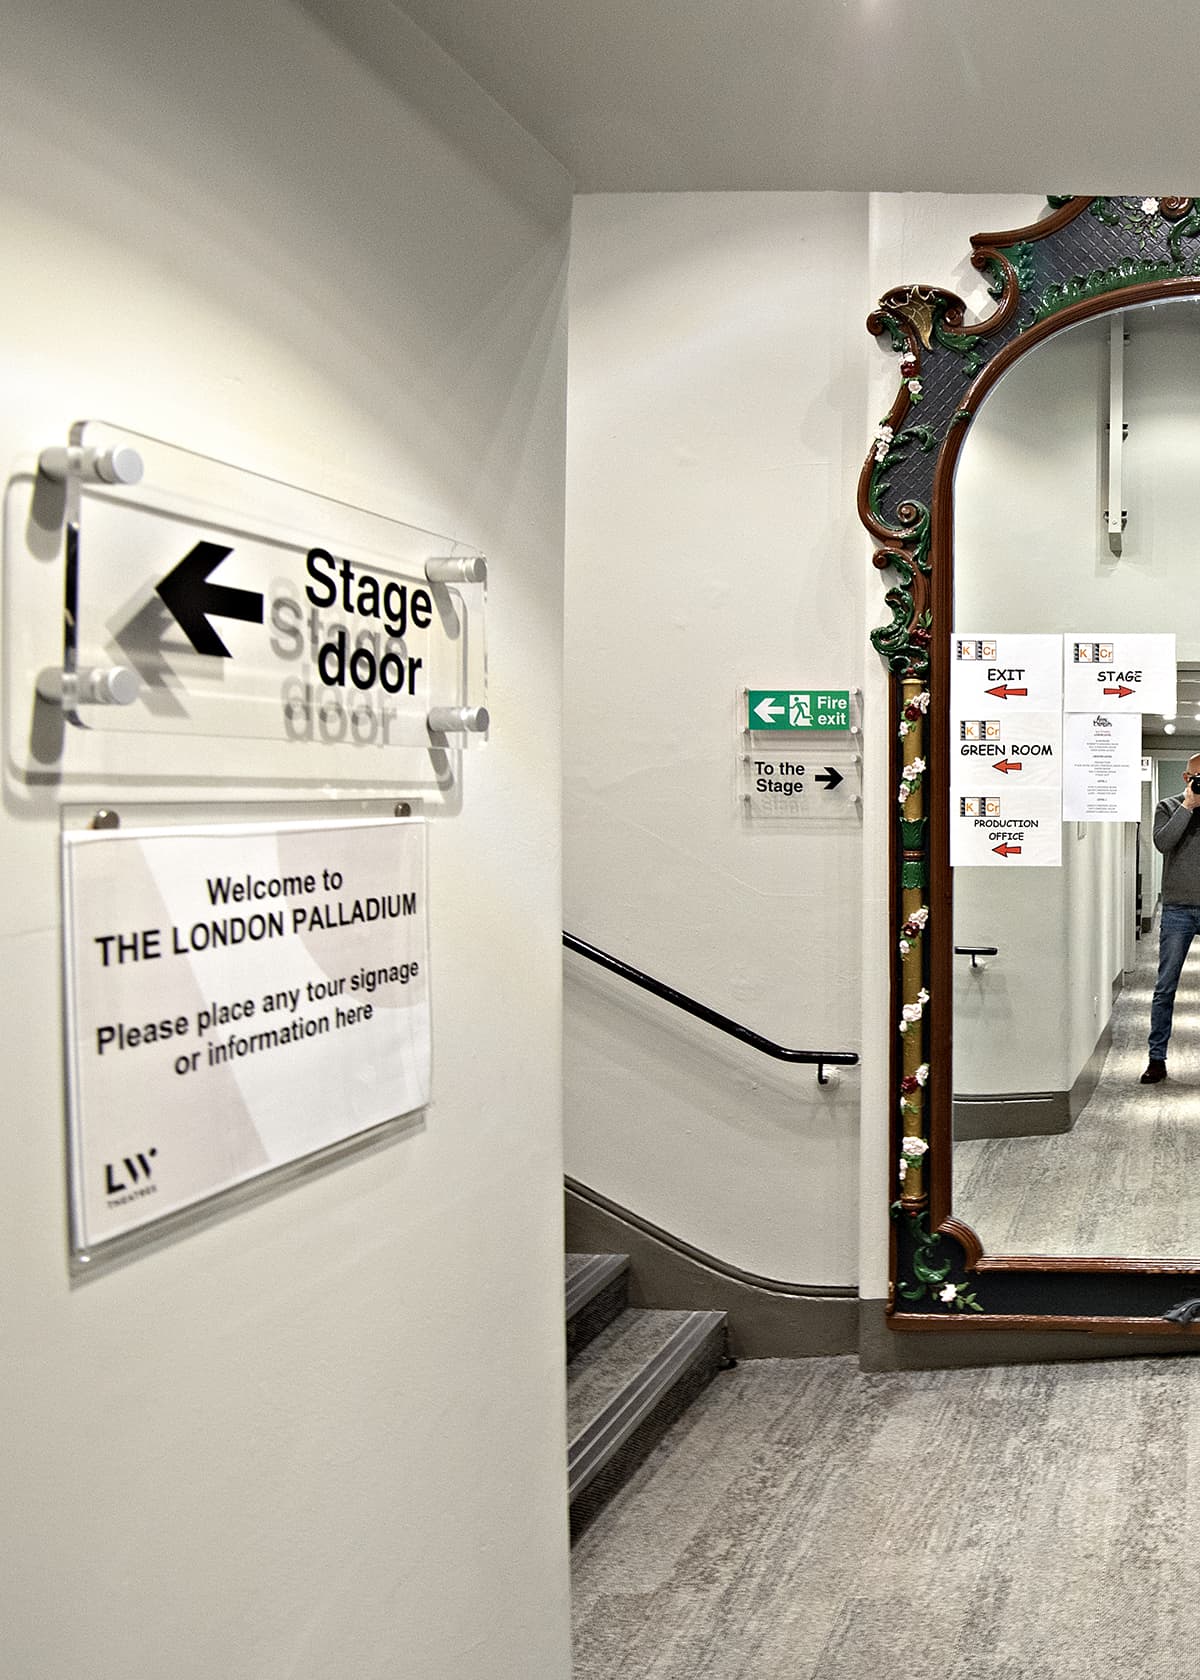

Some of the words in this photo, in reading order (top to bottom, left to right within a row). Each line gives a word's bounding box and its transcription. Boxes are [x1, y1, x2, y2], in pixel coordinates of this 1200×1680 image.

[305, 548, 432, 637] Stage
[963, 646, 970, 655] K
[983, 646, 995, 656] Cr
[1080, 649, 1087, 658] K
[1100, 649, 1112, 658] Cr
[317, 631, 422, 695] door
[987, 669, 1025, 681] EXIT
[1097, 671, 1142, 682] STAGE
[818, 696, 847, 709] Fire
[818, 712, 846, 725] exit
[966, 727, 974, 736] K
[986, 726, 999, 736] Cr
[960, 744, 1006, 756] GREEN
[1011, 745, 1053, 756] ROOM
[754, 762, 774, 775] To
[779, 762, 805, 775] the
[756, 778, 803, 796] Stage
[966, 803, 974, 812] K
[986, 803, 999, 812] Cr
[974, 819, 1039, 828] PRODUCTION
[988, 831, 1024, 841] OFFICE
[207, 873, 316, 905] Welcome
[322, 868, 343, 890] to
[94, 930, 161, 966] THE
[173, 911, 284, 955] LONDON
[293, 892, 417, 934] PALLADIUM
[97, 1015, 189, 1055] Please
[197, 998, 255, 1037] place
[262, 989, 299, 1013] any
[307, 977, 346, 1002] tour
[350, 960, 419, 992] signage
[175, 1050, 201, 1075] or
[208, 1015, 331, 1067] information
[335, 1002, 374, 1028] here
